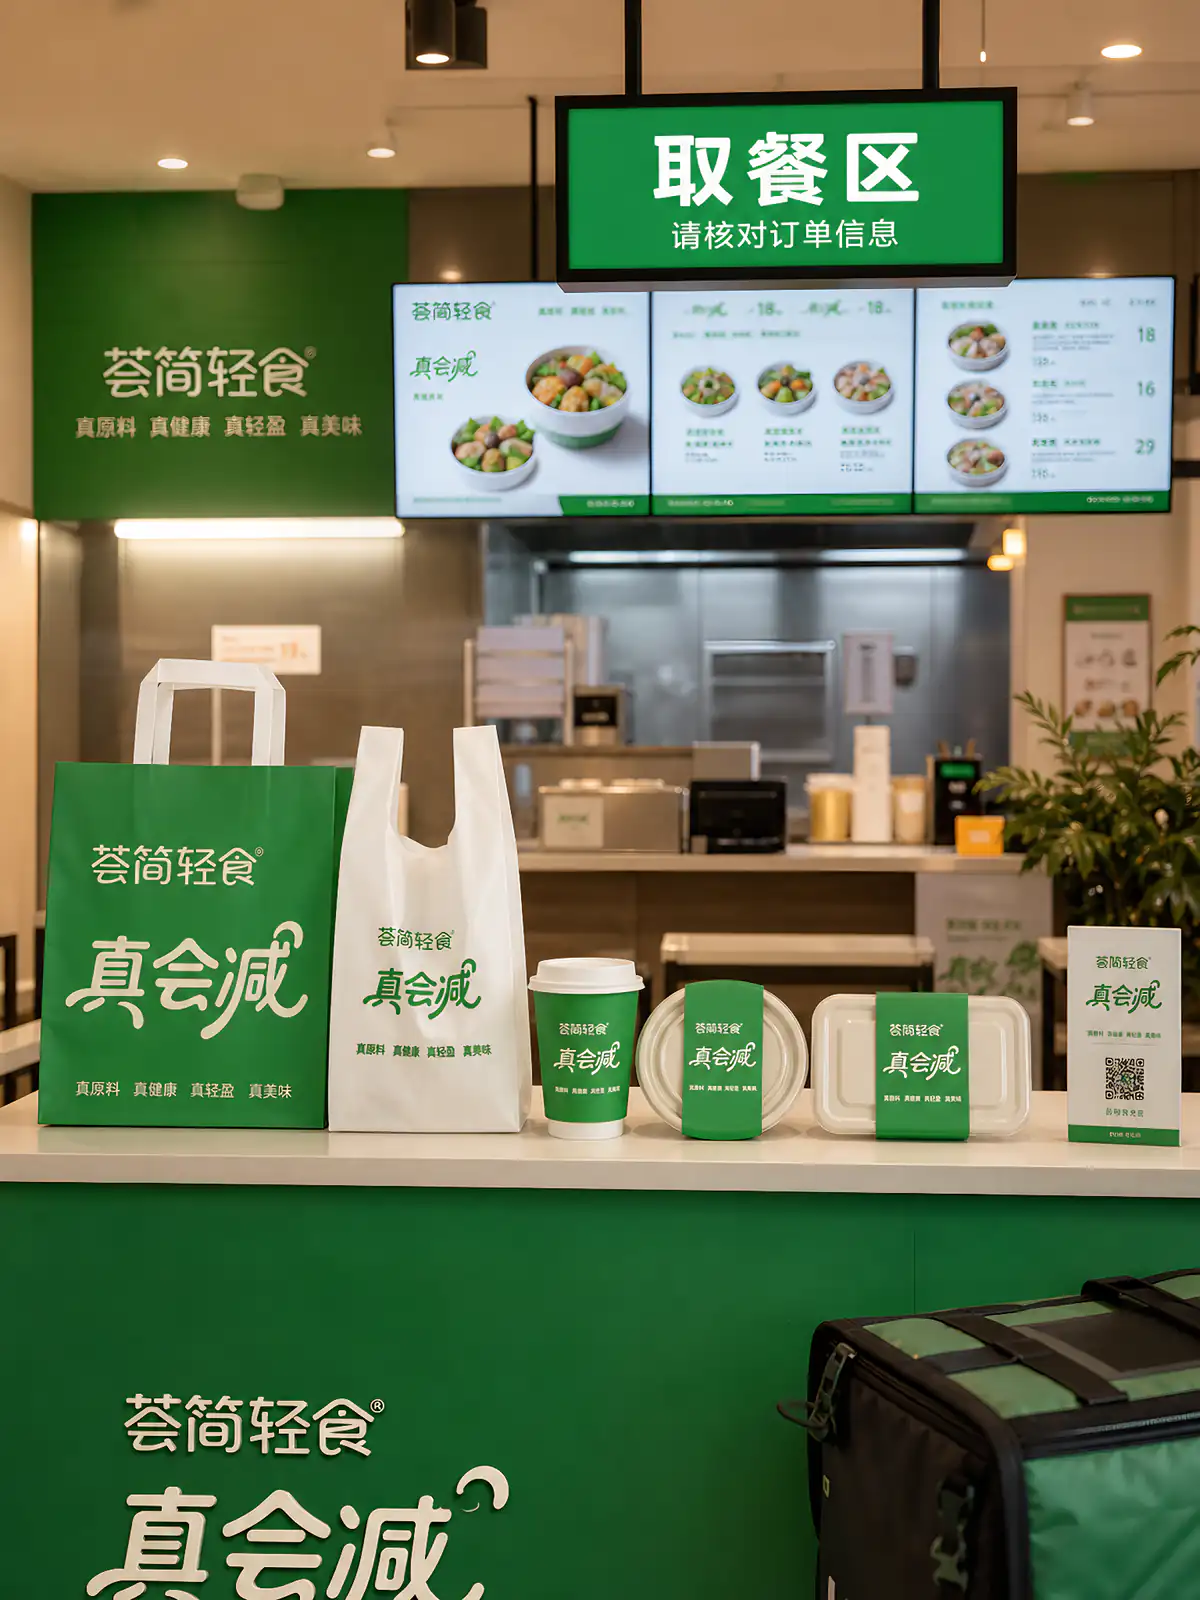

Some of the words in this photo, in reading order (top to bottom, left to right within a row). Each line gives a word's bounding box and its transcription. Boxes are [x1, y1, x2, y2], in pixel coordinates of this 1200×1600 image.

[653, 131, 919, 207] 取餐区
[671, 218, 899, 250] 请核对订单信息
[1138, 326, 1156, 343] 18
[410, 350, 478, 383] 真会减
[1137, 380, 1156, 397] 16
[76, 416, 136, 438] 真原料
[150, 416, 211, 438] 真健康
[224, 415, 286, 437] 真轻盈
[300, 414, 362, 437] 真美味
[65, 920, 309, 1040] 真会减
[362, 958, 482, 1020] 真会减
[1085, 979, 1163, 1015] 真会减
[553, 1040, 621, 1076] 真会减
[688, 1041, 757, 1073] 真会减
[882, 1045, 962, 1081] 真会减
[76, 1080, 121, 1097] 真原料
[133, 1081, 177, 1098] 真健康
[190, 1082, 235, 1099] 真轻盈
[248, 1083, 292, 1099] 真美味
[86, 1465, 510, 1600] 真会减
